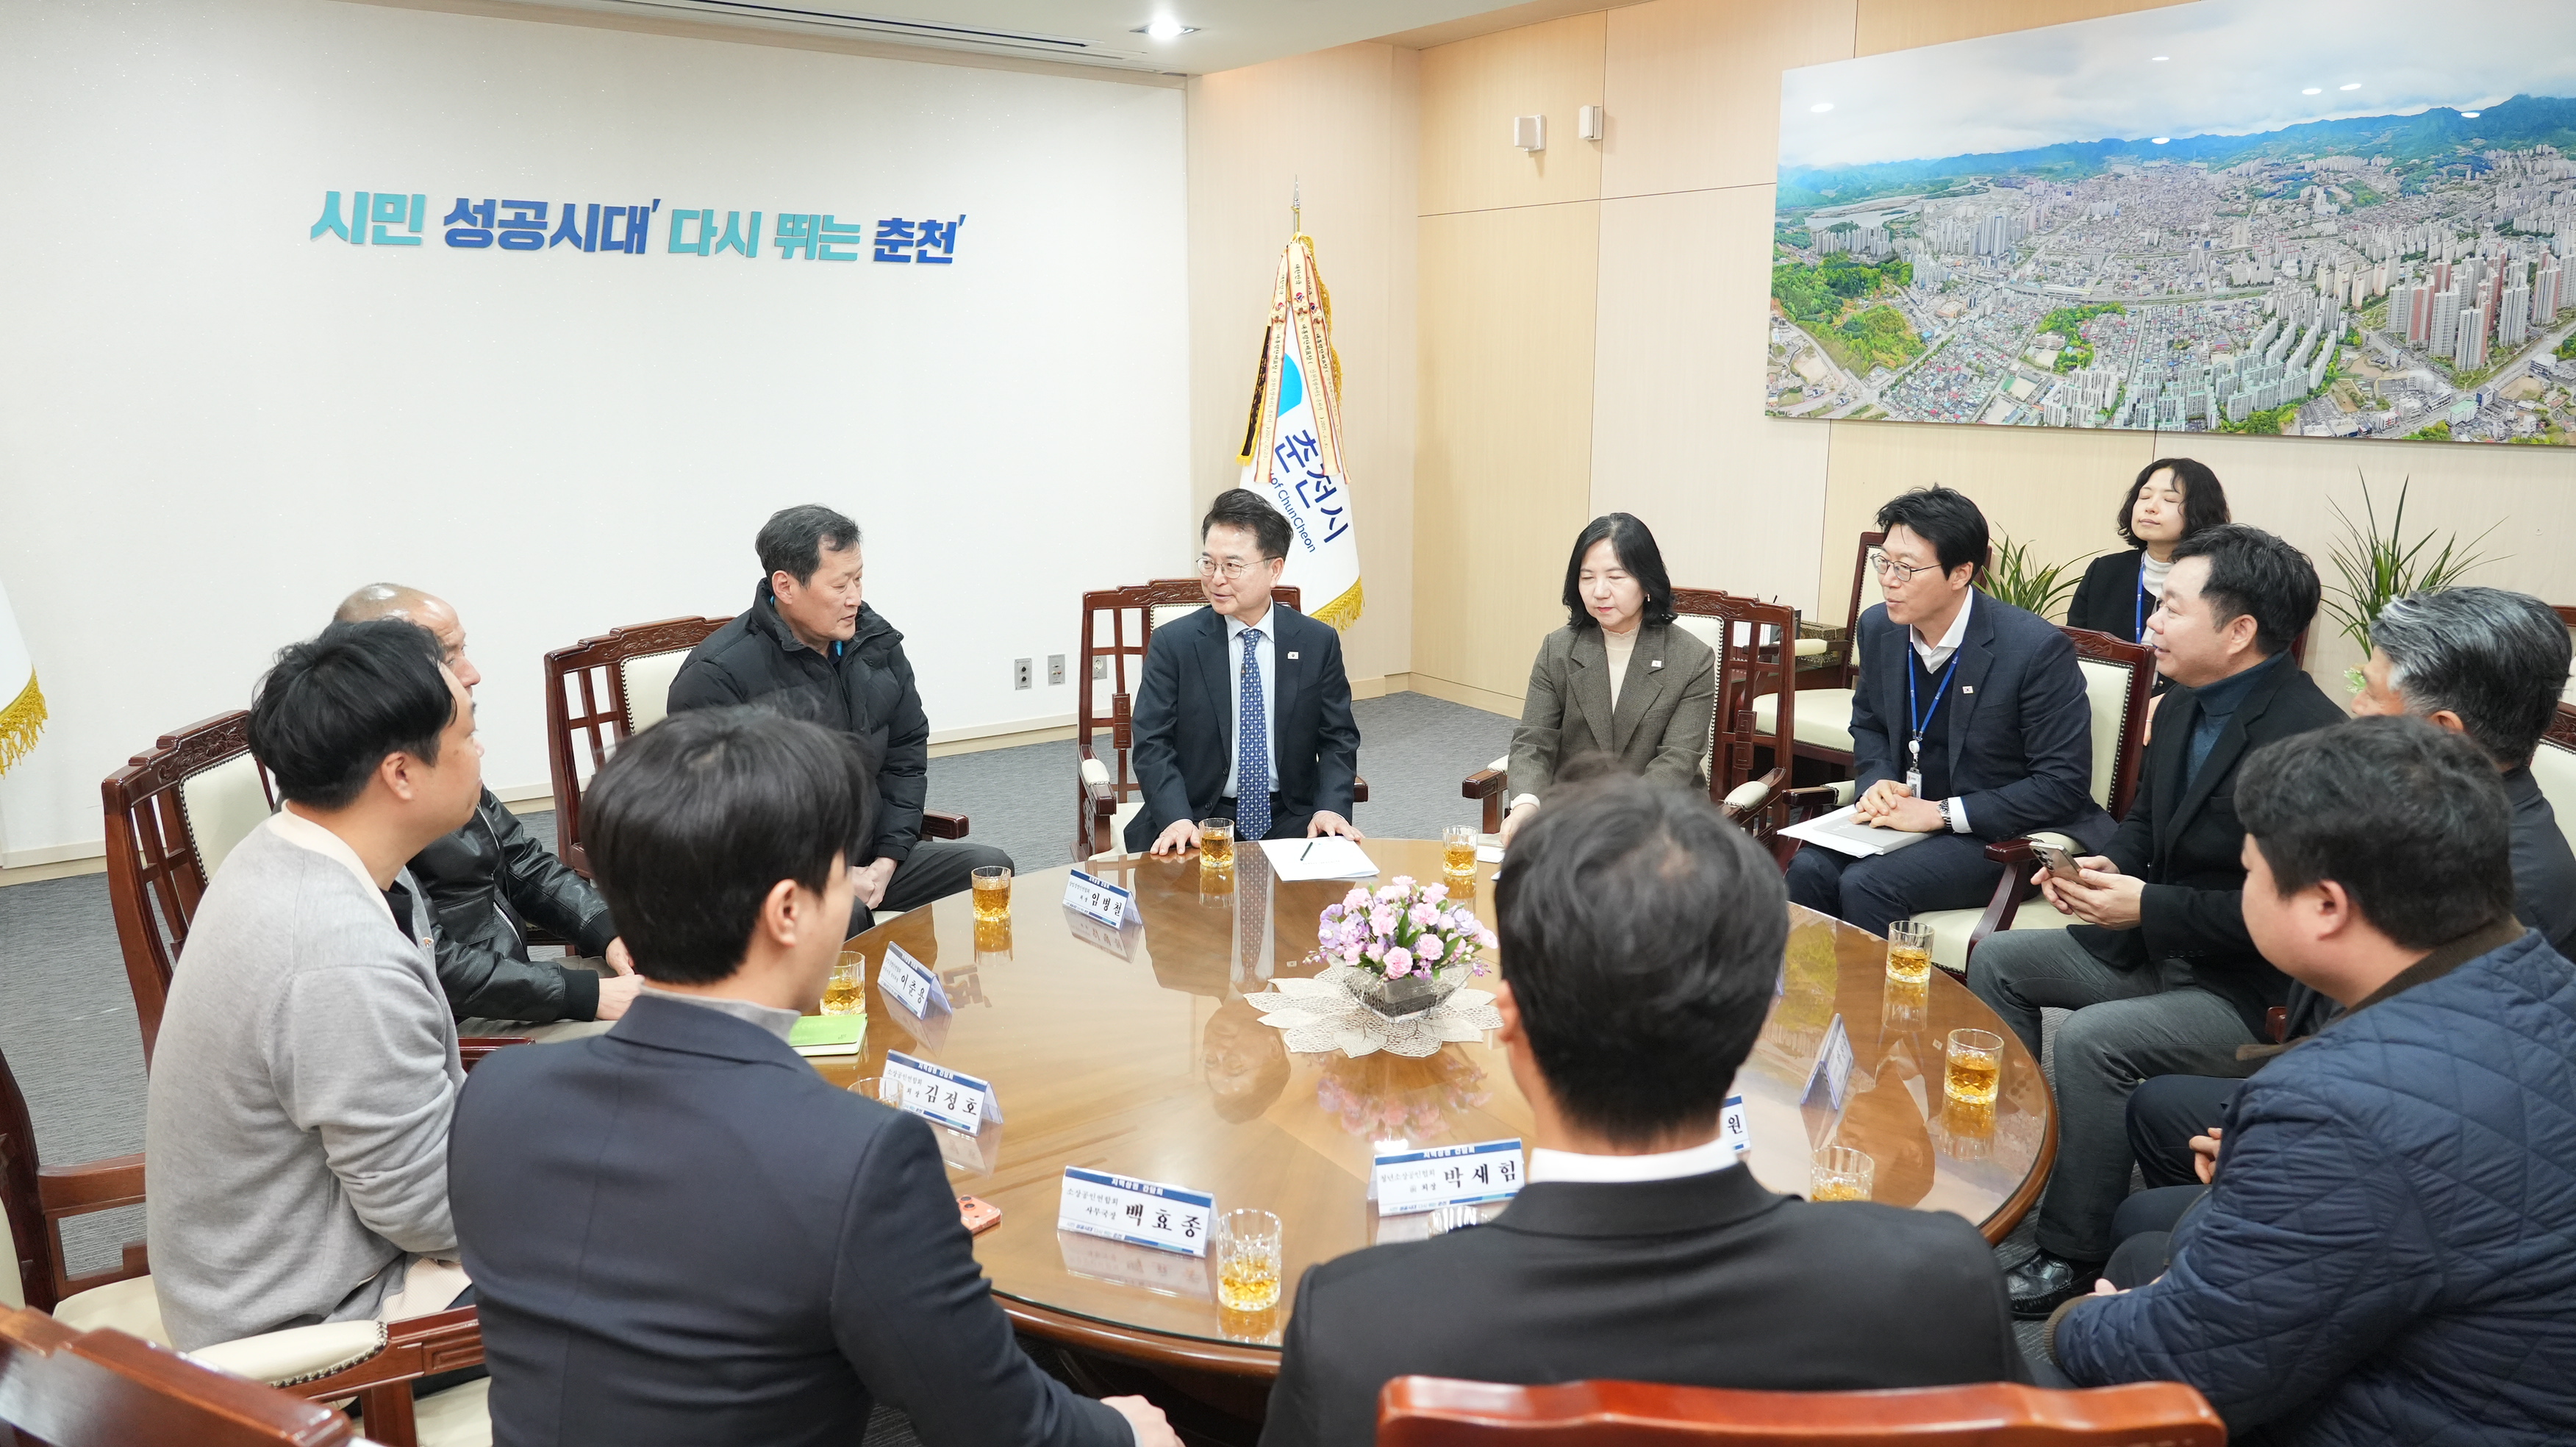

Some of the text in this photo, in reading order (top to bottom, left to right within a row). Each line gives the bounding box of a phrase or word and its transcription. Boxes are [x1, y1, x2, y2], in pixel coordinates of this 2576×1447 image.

[310, 191, 426, 246] 시민
[668, 209, 762, 257] 다시
[774, 213, 861, 261] 뛰는
[1270, 477, 1316, 553] of ChunCheon
[1275, 429, 1349, 543] 춘천시
[1067, 1188, 1119, 1206] 소상공인연합회
